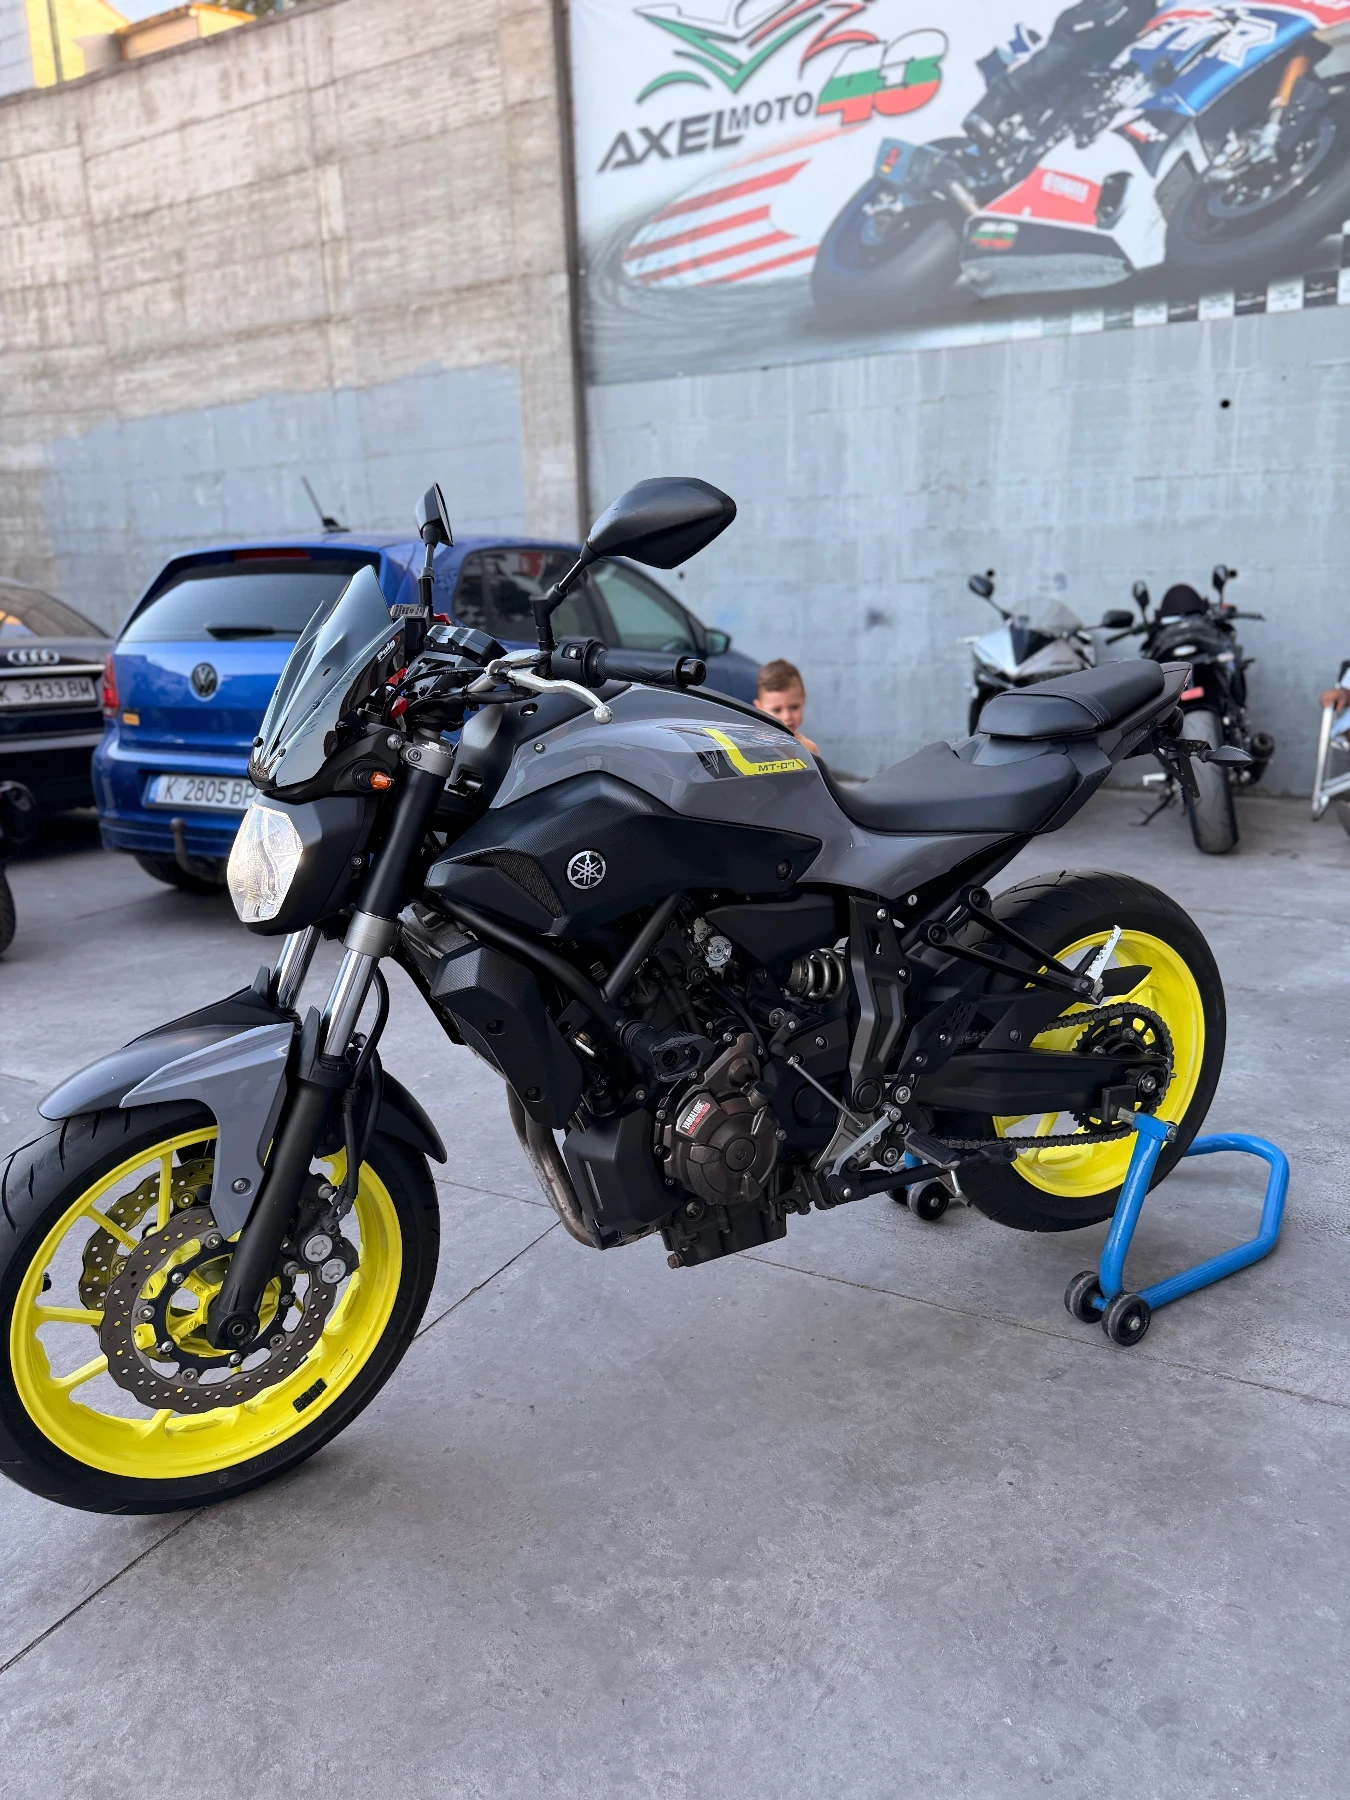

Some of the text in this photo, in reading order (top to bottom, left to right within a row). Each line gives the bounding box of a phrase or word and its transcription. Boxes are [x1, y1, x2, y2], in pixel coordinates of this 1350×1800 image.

[597, 109, 744, 174] AXEL
[728, 91, 813, 133] MOTO
[20, 681, 65, 701] 3433
[758, 761, 795, 772] MT-07
[164, 776, 257, 806] K 2805 BP
[682, 1099, 706, 1130] YAMALUBE
